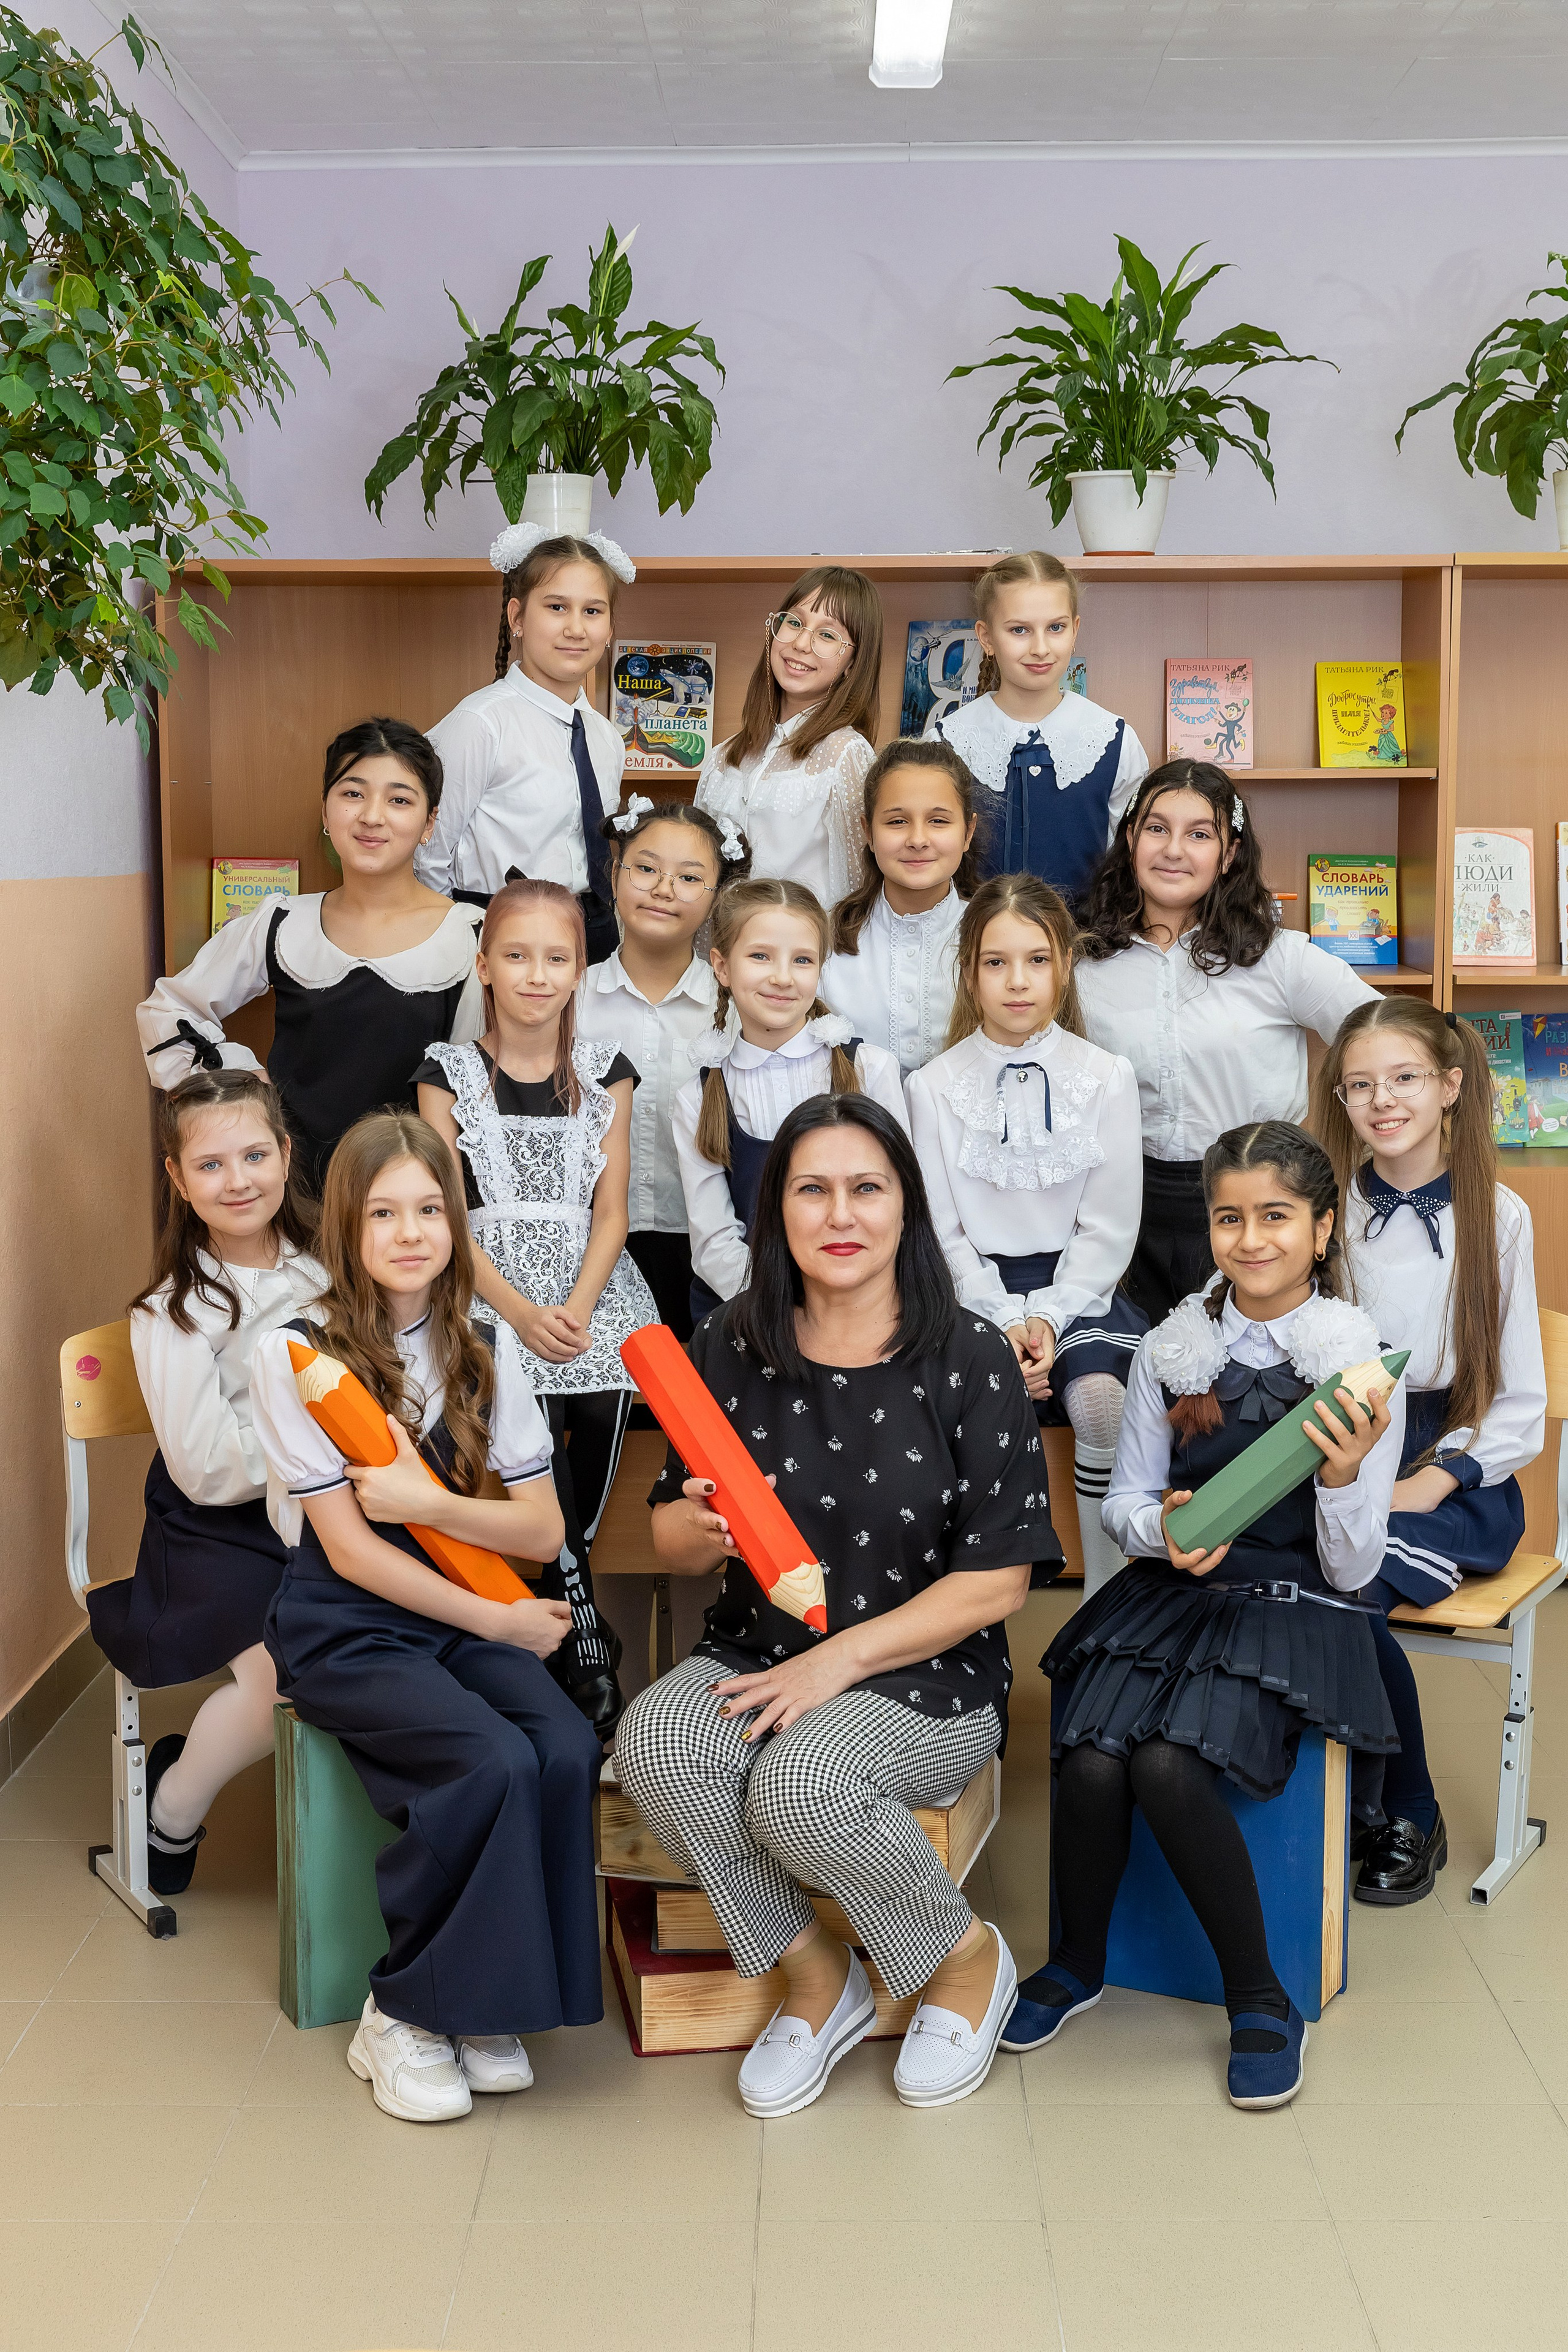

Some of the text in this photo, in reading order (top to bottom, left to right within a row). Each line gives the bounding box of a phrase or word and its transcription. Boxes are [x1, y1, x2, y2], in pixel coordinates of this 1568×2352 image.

[617, 674, 662, 690] Наша
[644, 718, 707, 730] планета
[625, 757, 664, 768] емля
[1468, 854, 1492, 862] КАК
[1321, 873, 1384, 883] СЛОВАРЬ
[222, 884, 290, 896] СЛОВАРЬ
[1316, 884, 1389, 897] УДАРЕНИЙ
[1461, 883, 1499, 892] ЖИЛИ
[1545, 1031, 1568, 1044] РАЗ
